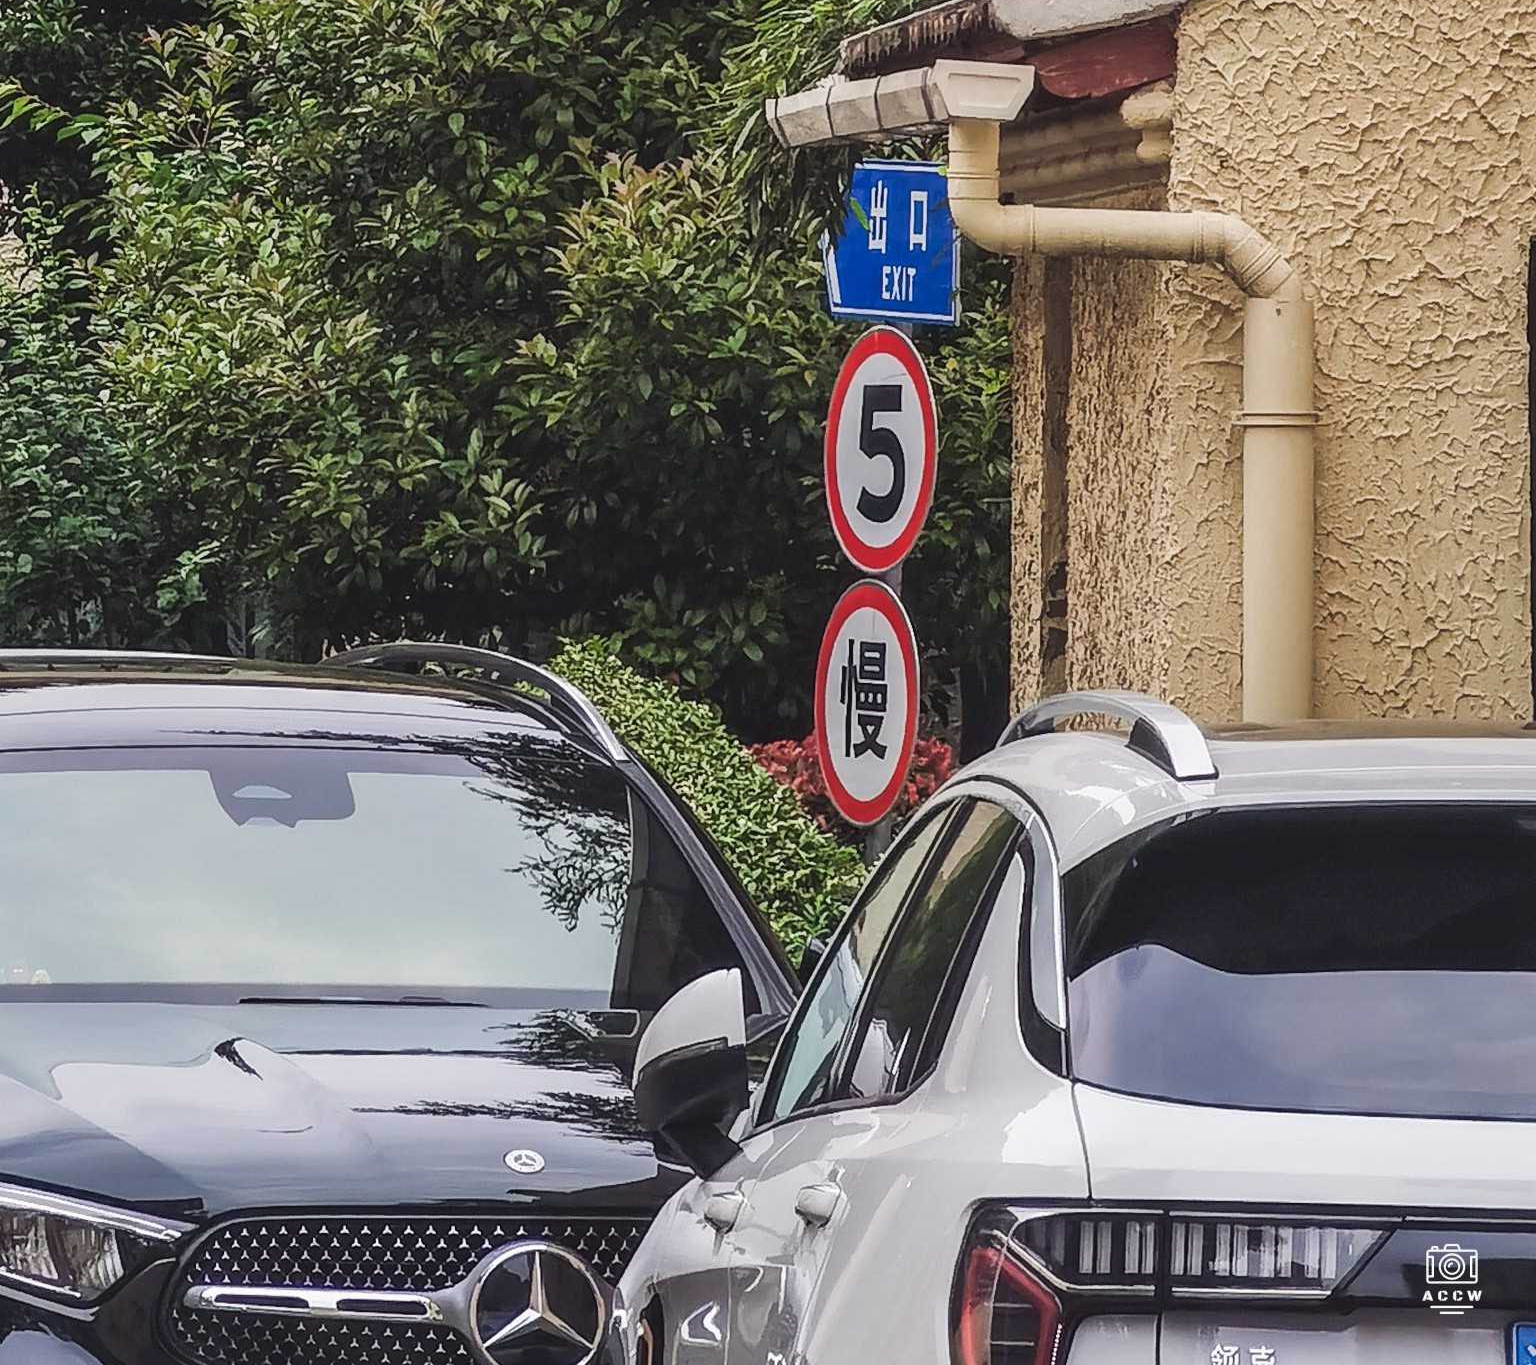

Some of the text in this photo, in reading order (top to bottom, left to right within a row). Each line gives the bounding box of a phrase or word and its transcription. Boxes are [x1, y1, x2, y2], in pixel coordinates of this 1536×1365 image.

[868, 180, 928, 254] 出口
[882, 265, 917, 302] EXIT
[856, 384, 906, 523] 5
[840, 638, 888, 760] 慢
